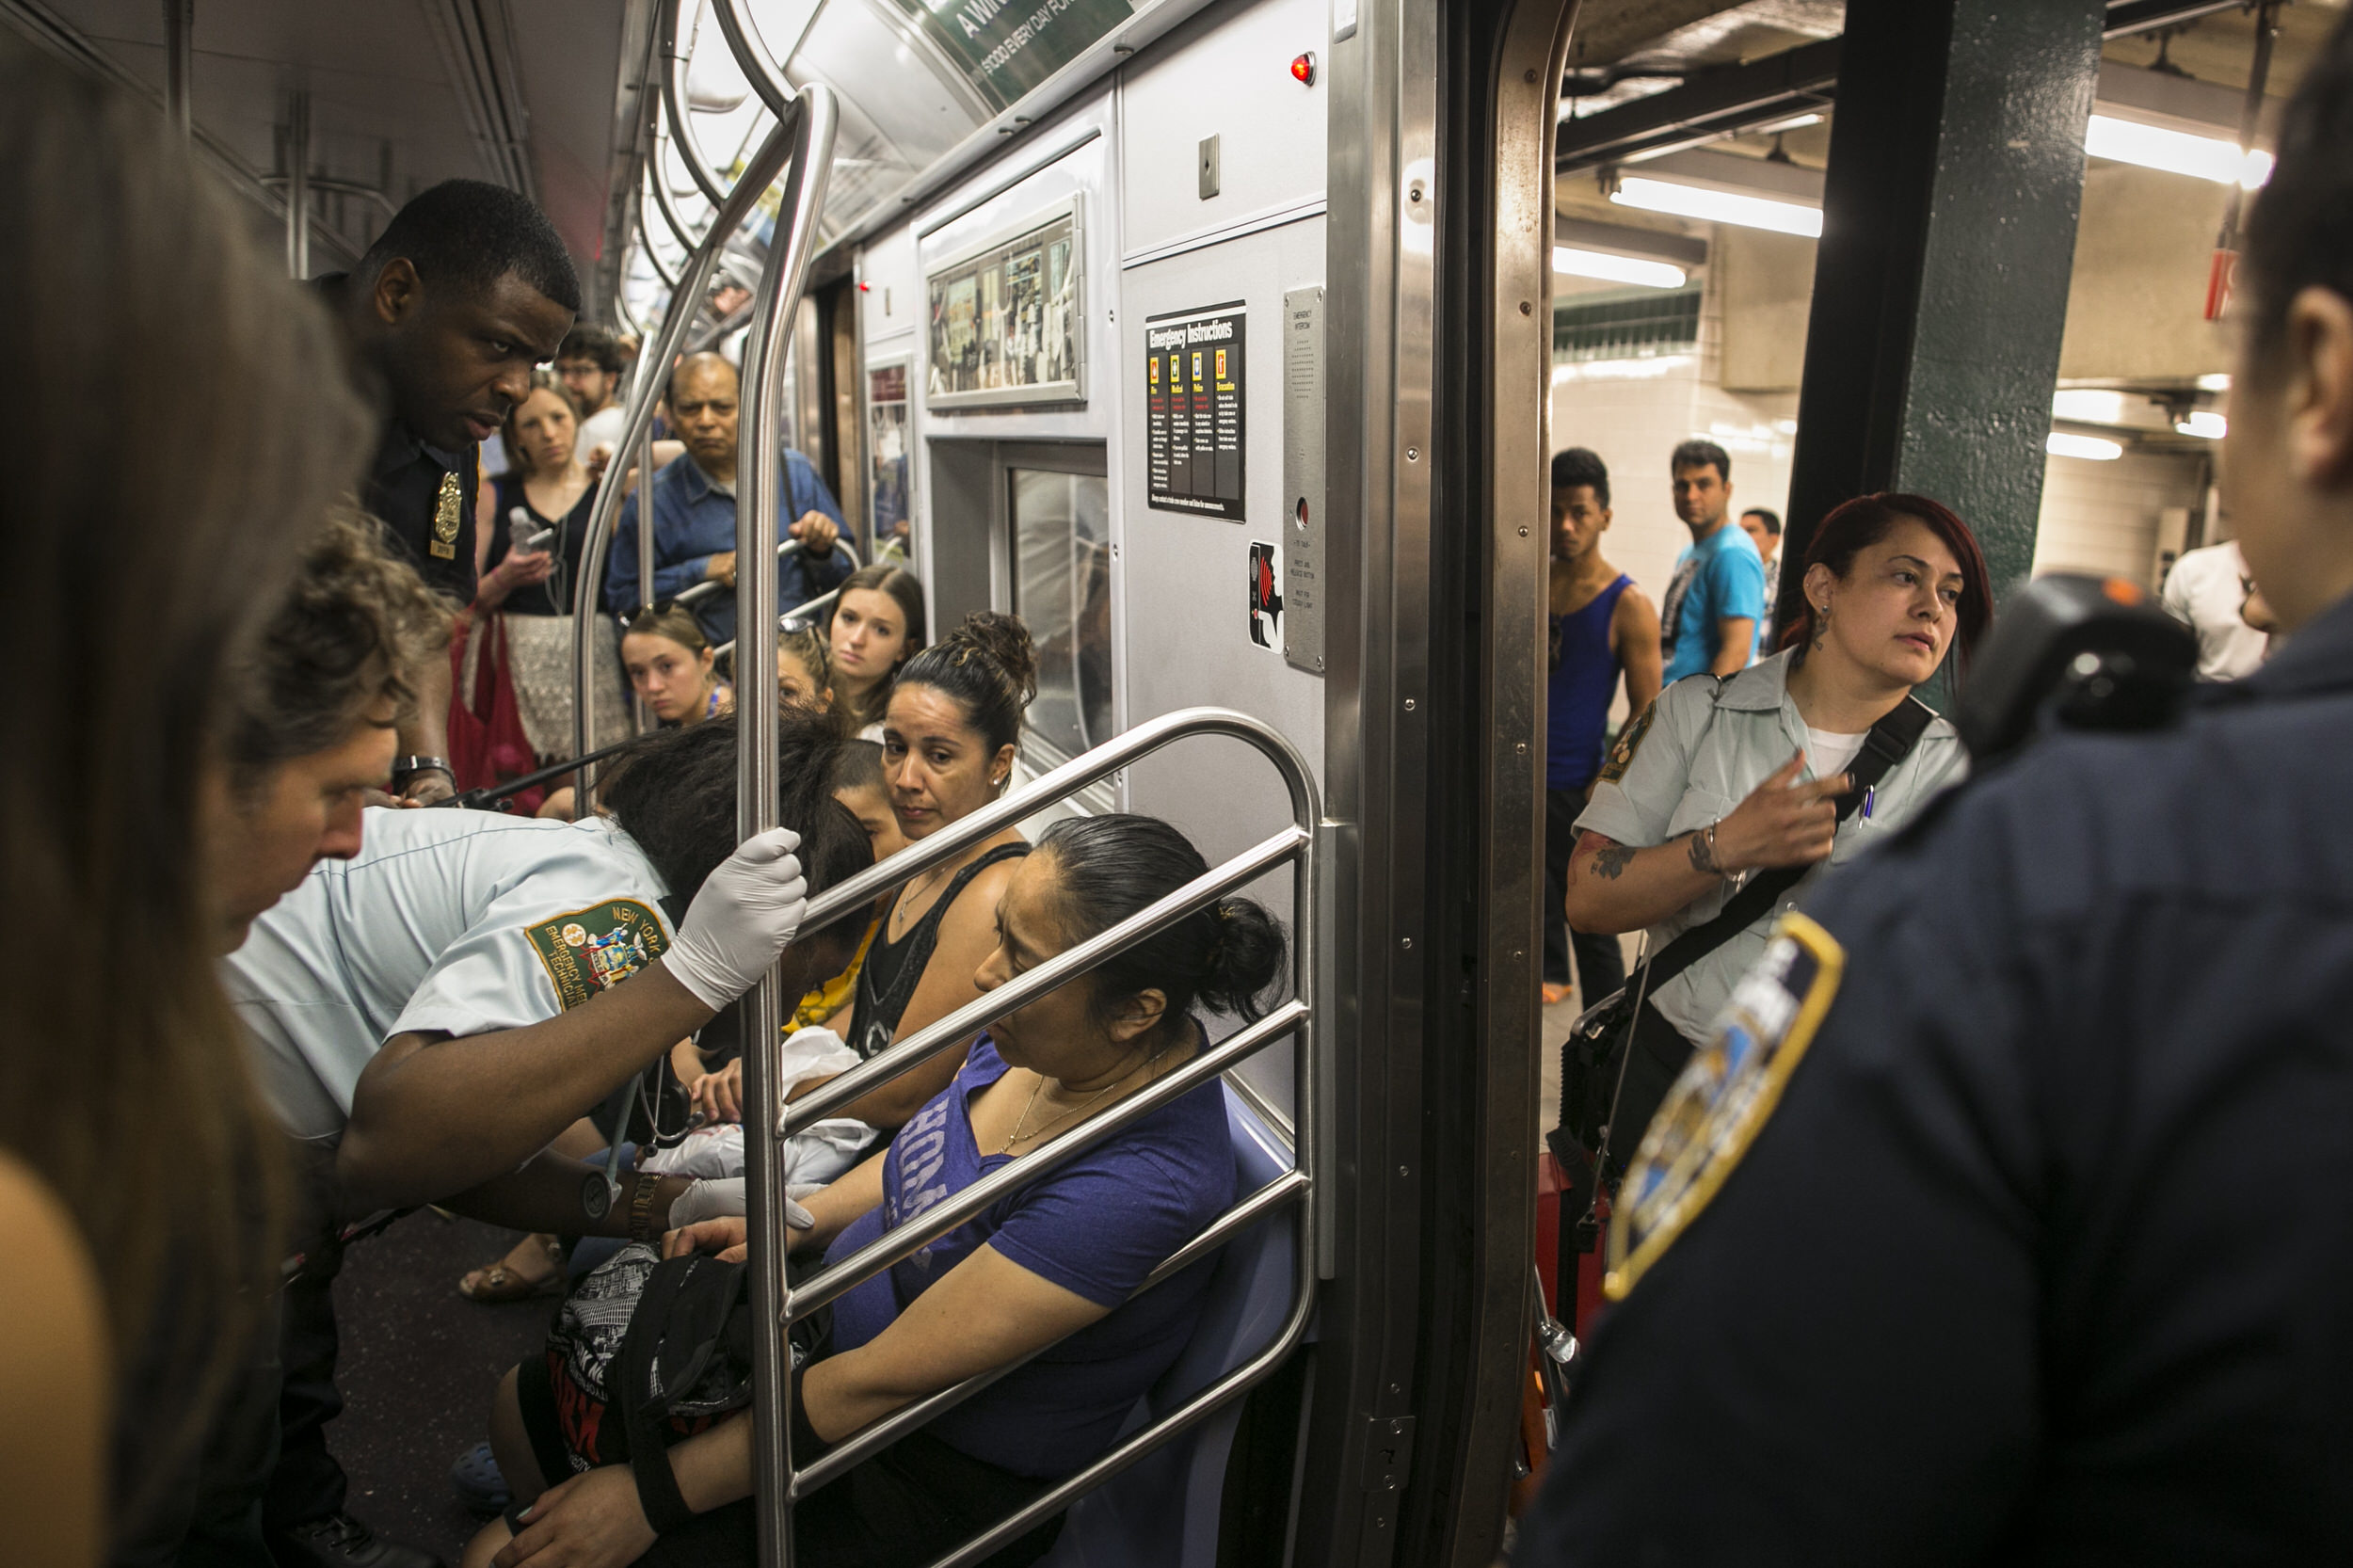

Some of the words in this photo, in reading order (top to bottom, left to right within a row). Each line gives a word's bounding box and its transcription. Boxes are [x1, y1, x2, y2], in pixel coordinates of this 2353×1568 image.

[956, 13, 981, 39] A
[1003, 21, 1036, 55] EVERY
[1030, 5, 1054, 31] DAY
[1149, 328, 1187, 350] Emergency
[1187, 319, 1233, 344] Instructions
[612, 906, 639, 923] NEW
[640, 919, 662, 952] YORK
[545, 925, 581, 982] EMERGENCY
